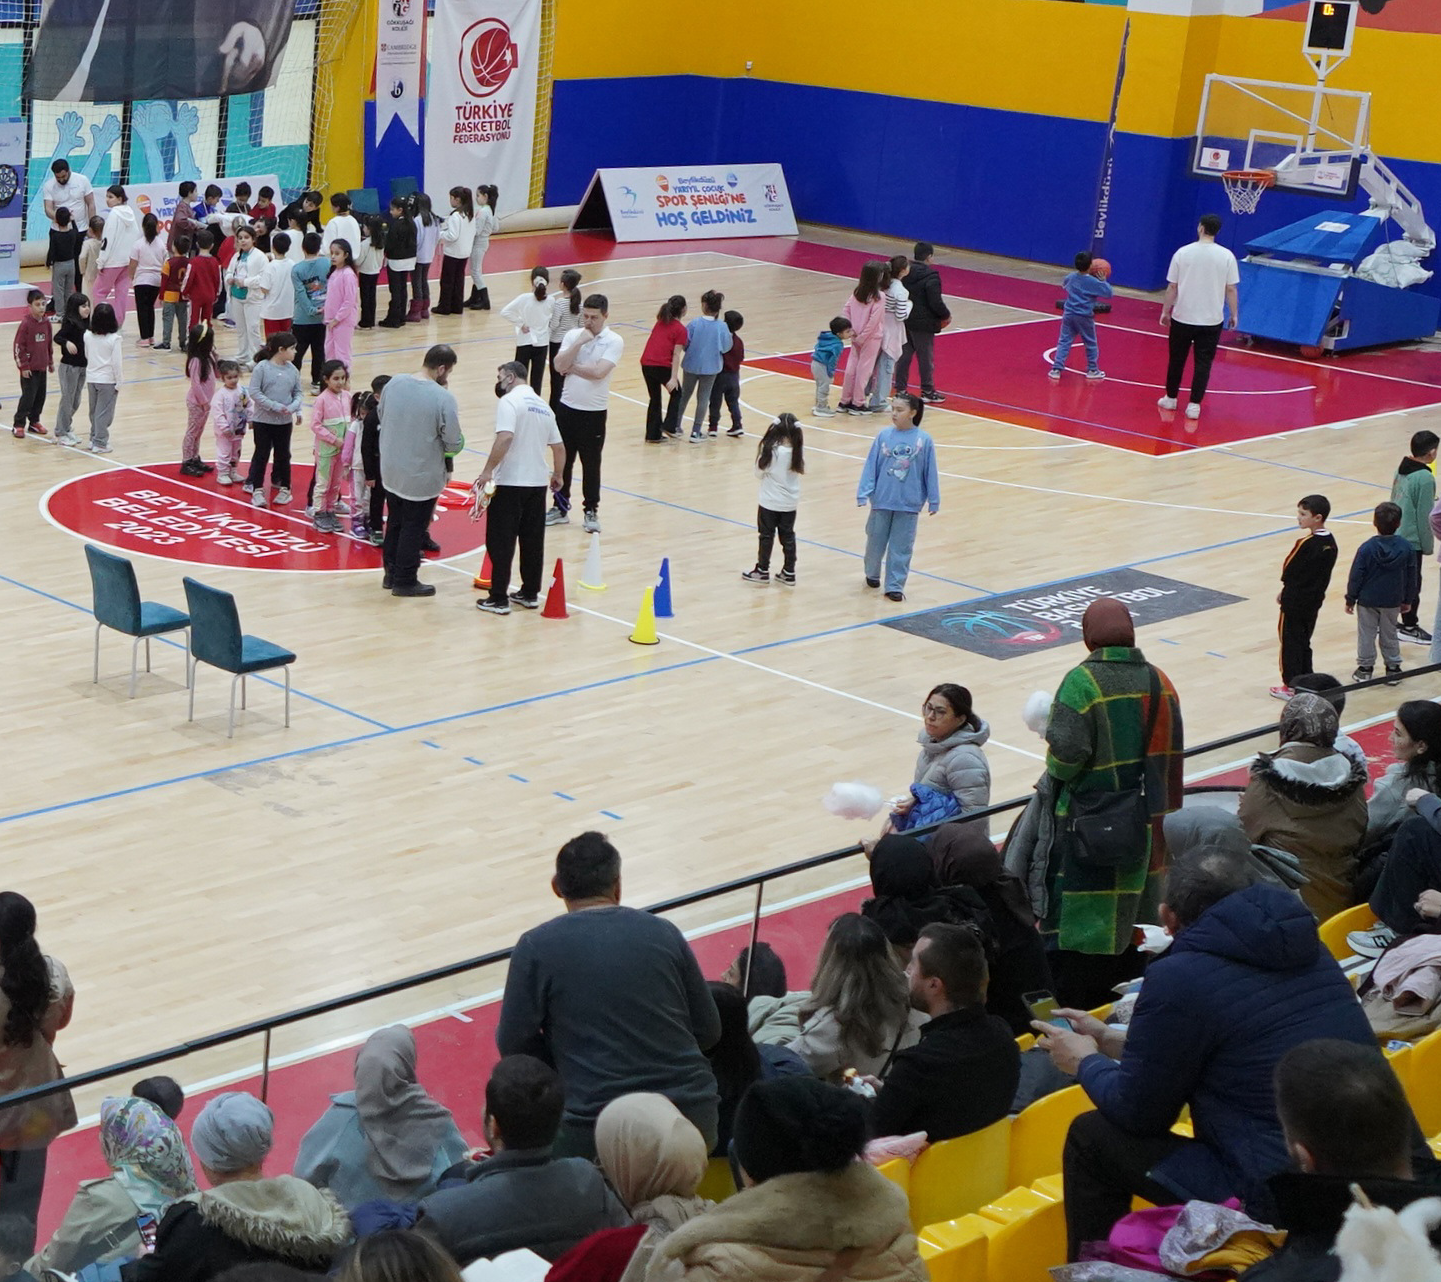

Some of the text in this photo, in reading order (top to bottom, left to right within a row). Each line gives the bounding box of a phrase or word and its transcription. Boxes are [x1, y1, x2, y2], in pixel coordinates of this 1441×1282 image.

[455, 100, 514, 121] TÜRKİYE
[453, 131, 511, 144] FEDERASYONU
[455, 119, 511, 133] BASKETBOL
[656, 194, 688, 208] SPOR
[655, 208, 757, 231] HOŞ GELDİNİZ
[93, 497, 290, 558] BELEDİYESİ
[103, 520, 186, 545] 2023
[124, 489, 331, 553] BEYLİKDÜZÜ
[1002, 585, 1113, 613] TÜRKİYE
